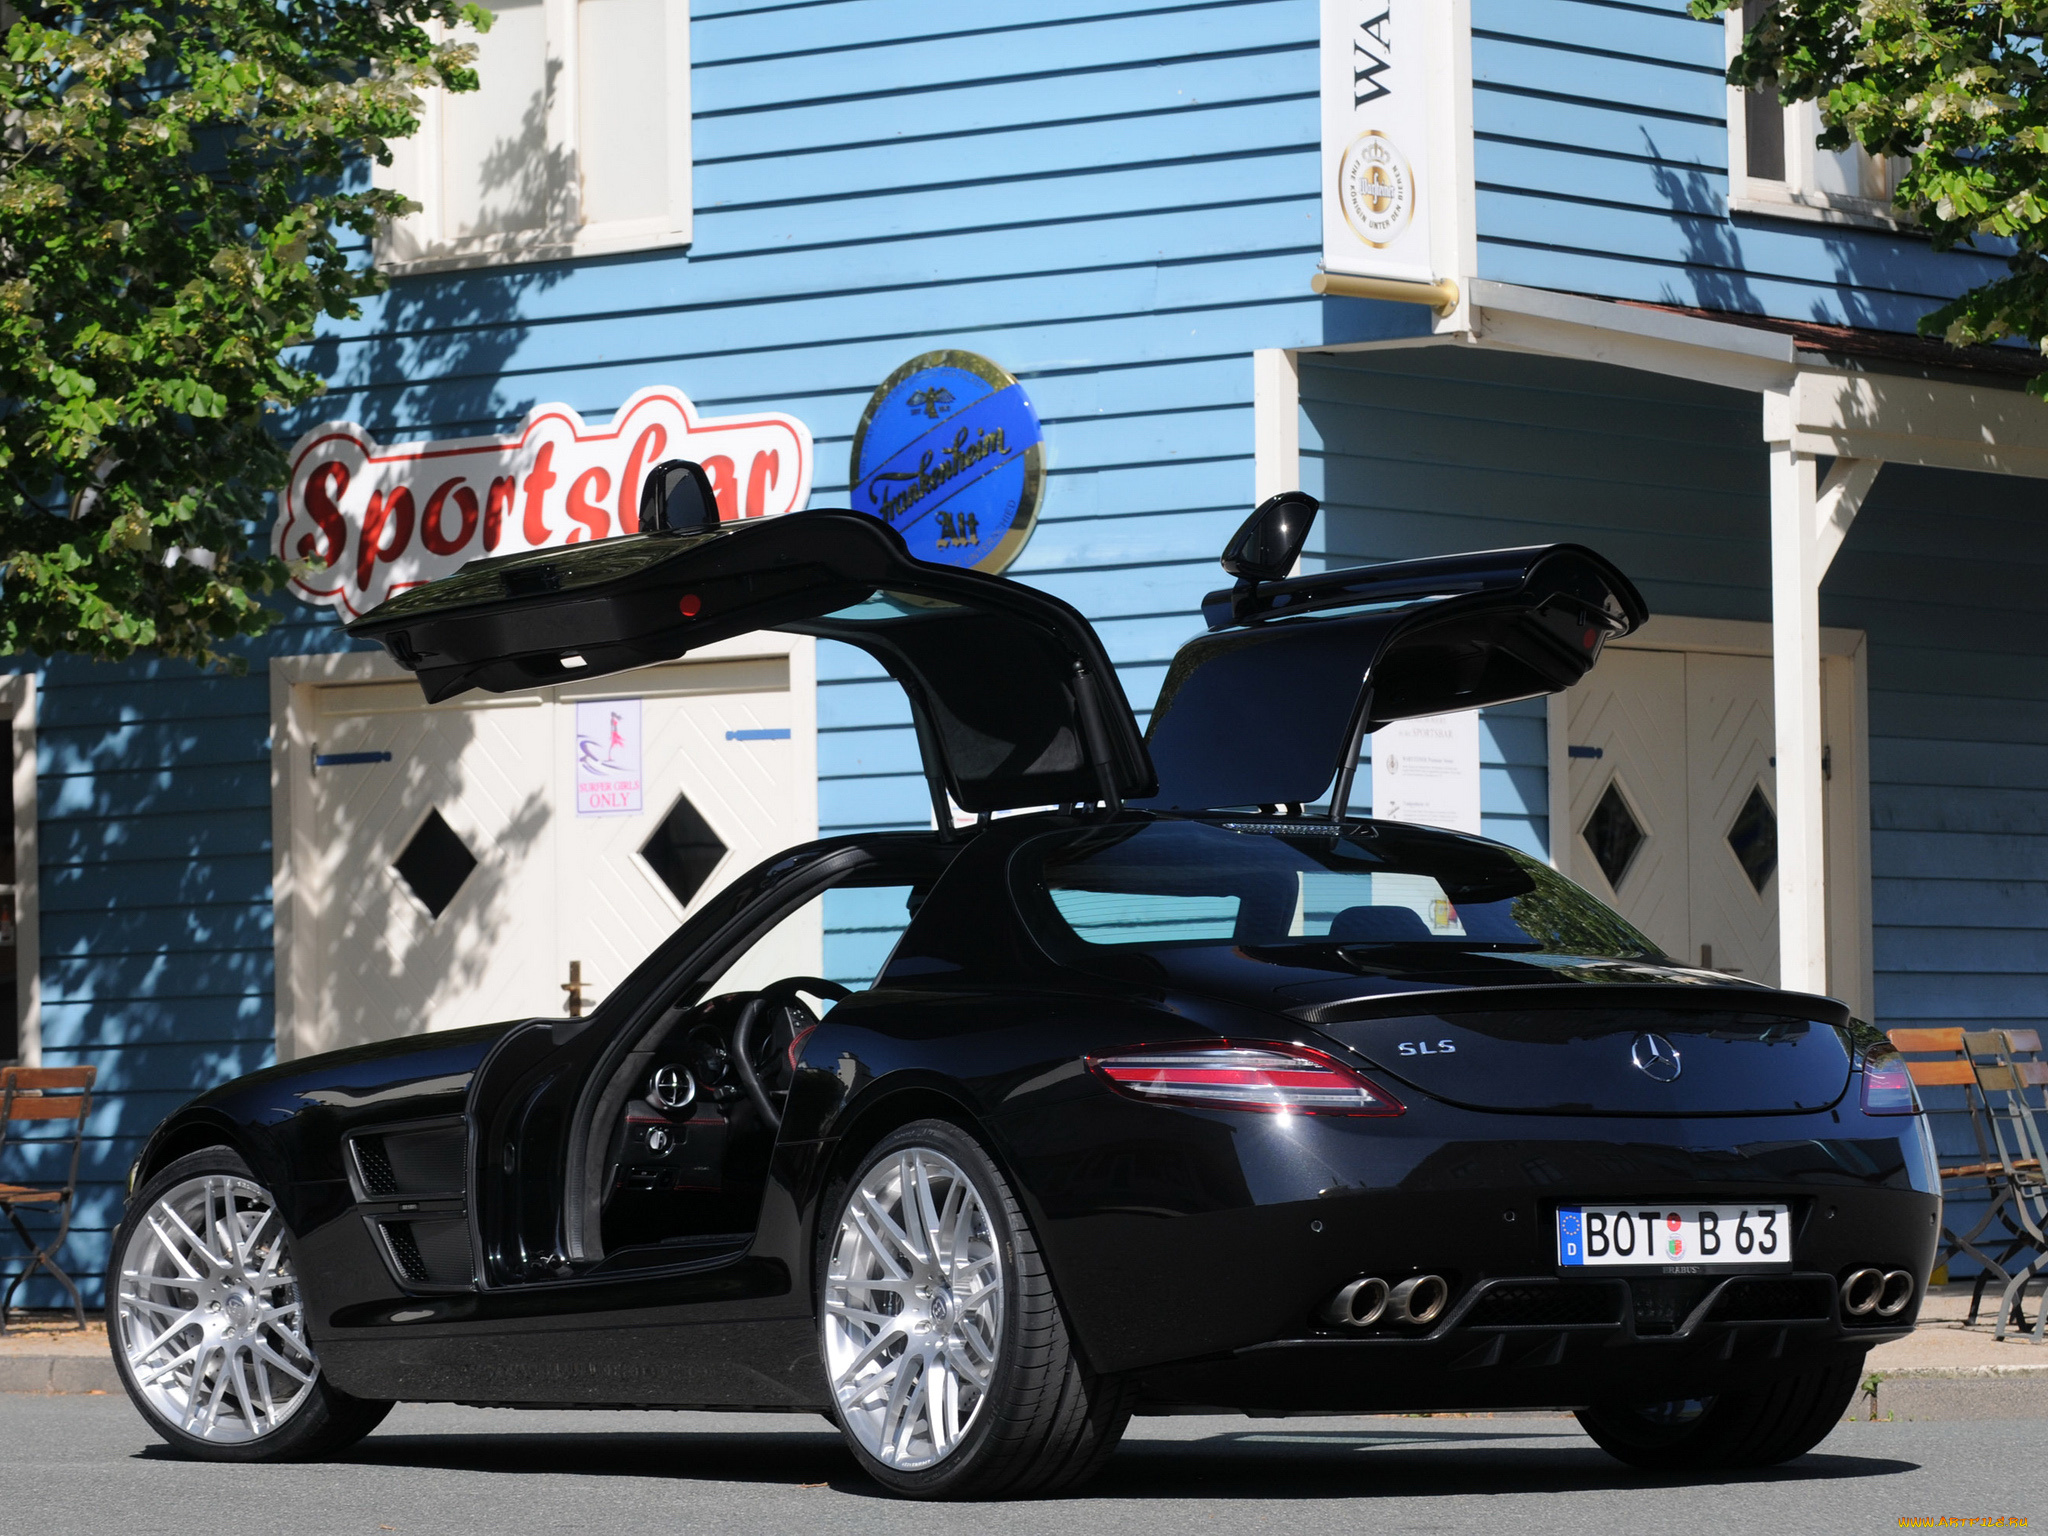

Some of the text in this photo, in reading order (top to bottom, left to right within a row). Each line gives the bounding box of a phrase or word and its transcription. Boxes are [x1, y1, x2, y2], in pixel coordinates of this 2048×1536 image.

[1353, 0, 1391, 111] WA
[1369, 219, 1390, 230] UNTER
[1391, 204, 1401, 221] DEN
[868, 427, 1012, 523] Frankenheim
[934, 511, 980, 550] Alt
[580, 780, 640, 792] SURFER GIRLS
[589, 792, 630, 808] ONLY
[1397, 1039, 1456, 1056] SLS
[1586, 1210, 1777, 1257] BOT B 63
[1567, 1243, 1577, 1256] D
